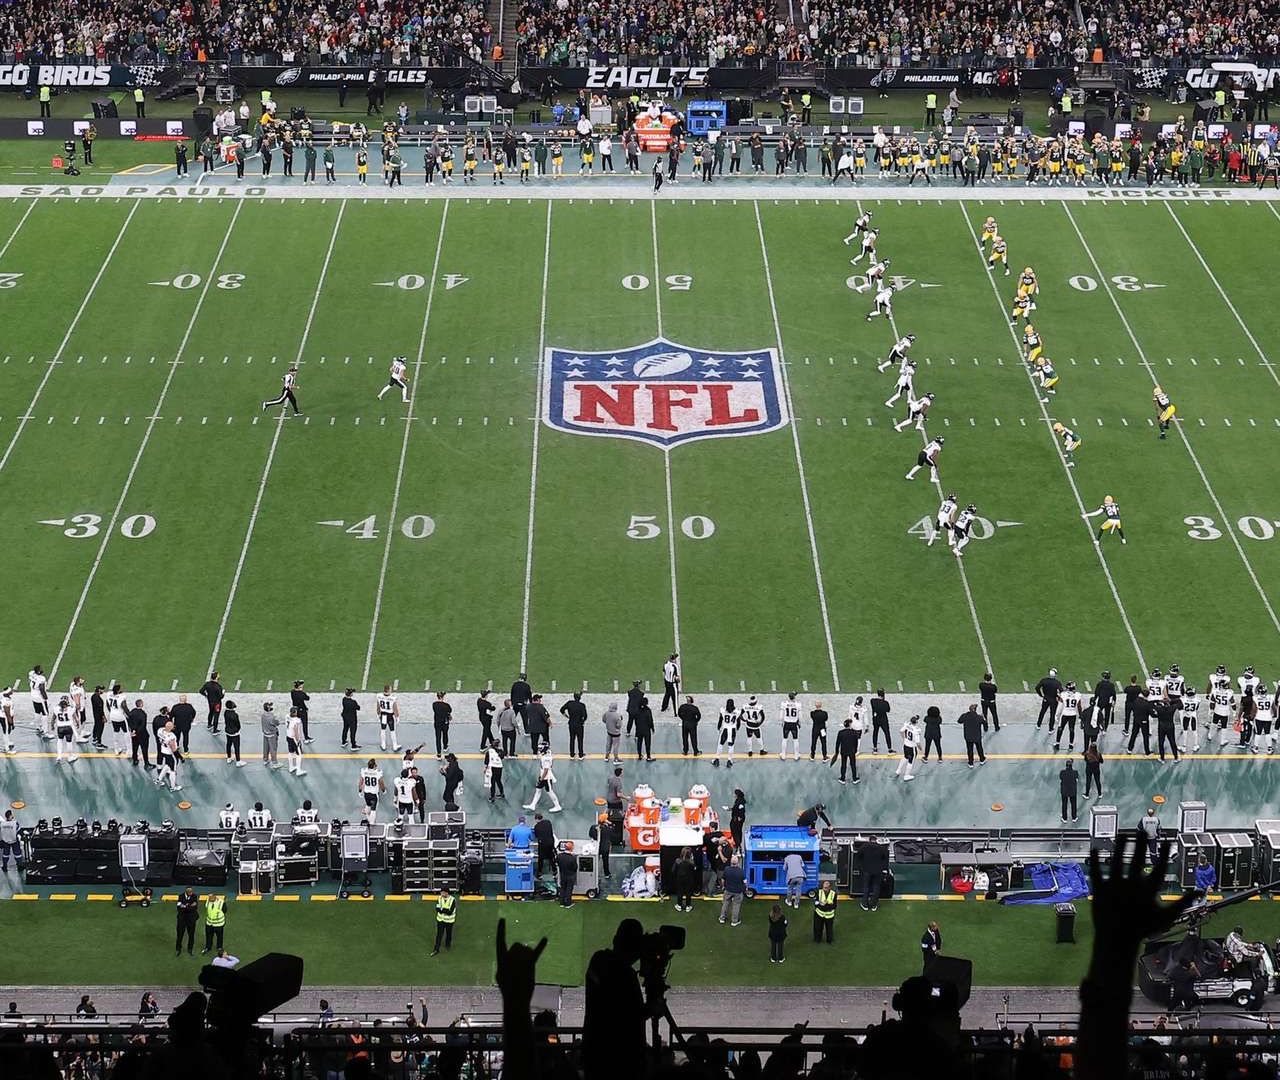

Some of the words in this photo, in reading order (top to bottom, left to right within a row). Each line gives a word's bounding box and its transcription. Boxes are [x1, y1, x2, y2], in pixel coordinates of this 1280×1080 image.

[37, 65, 112, 86] BIRDS
[309, 73, 364, 82] PHILADPHIA
[368, 70, 427, 83] EGLES
[586, 67, 710, 89] EAGLES
[904, 75, 960, 83] PHILADELPHIA
[1186, 68, 1220, 89] GO
[126, 186, 268, 196] PAULO
[1087, 189, 1234, 200] KICKOFF
[573, 384, 760, 432] NFL
[1106, 506, 1117, 517] 24
[63, 514, 157, 539] 30
[345, 515, 436, 539] 40
[626, 515, 716, 540] 50
[907, 515, 996, 540] 40
[1183, 516, 1276, 541] 30
[1149, 685, 1162, 696] 53
[1168, 682, 1181, 692] 27
[1065, 698, 1077, 708] 19
[1215, 695, 1228, 706] 55
[1257, 701, 1271, 711] 59
[785, 706, 797, 717] 16
[724, 713, 737, 724] 84
[364, 776, 377, 788] 88
[252, 816, 264, 827] 11
